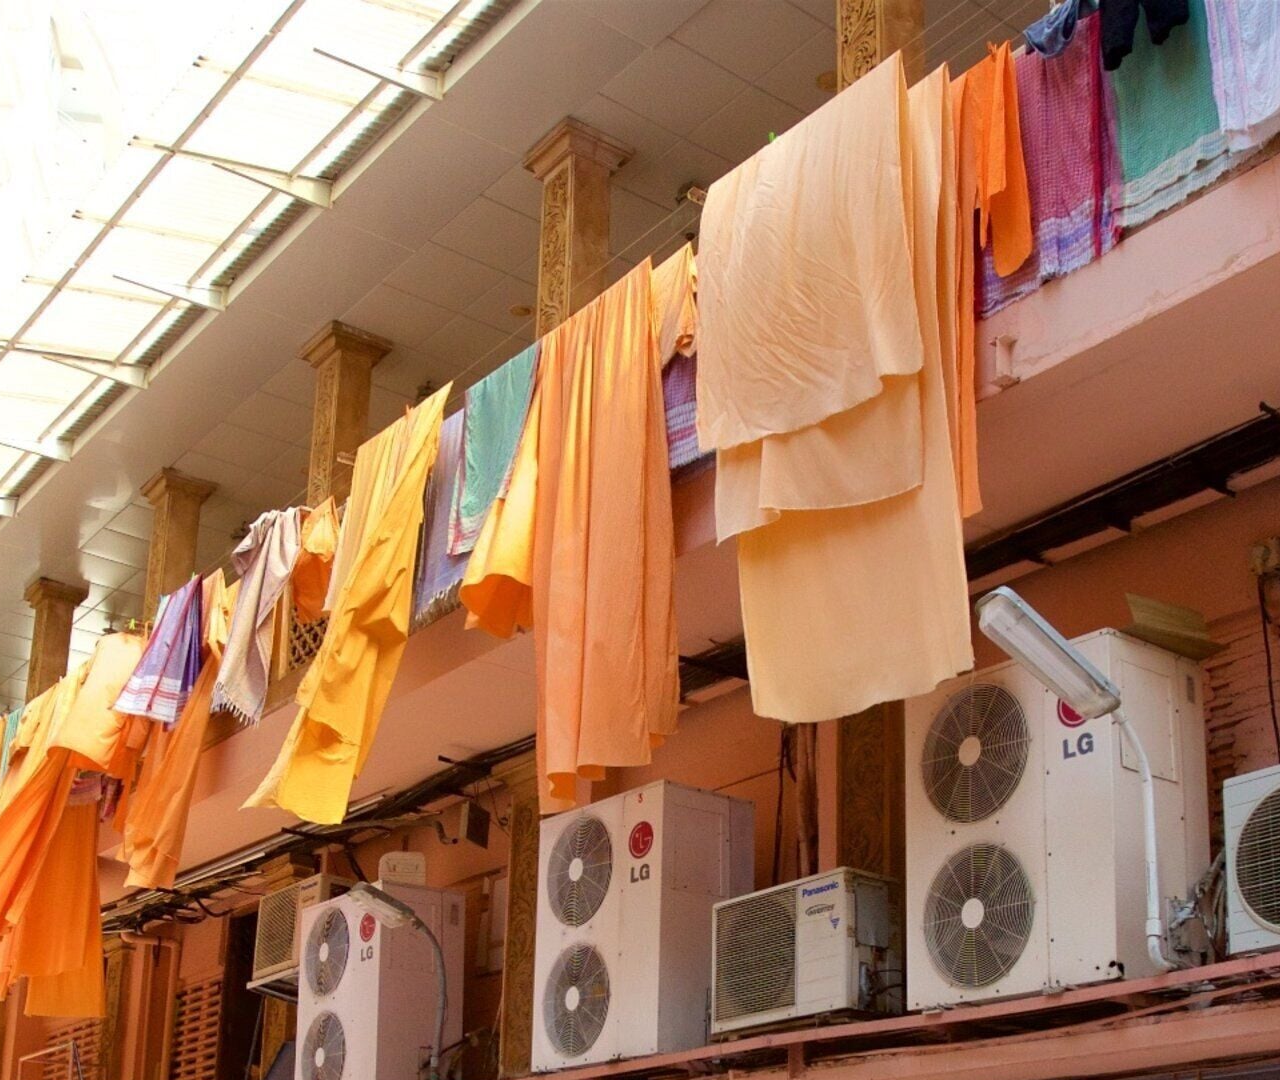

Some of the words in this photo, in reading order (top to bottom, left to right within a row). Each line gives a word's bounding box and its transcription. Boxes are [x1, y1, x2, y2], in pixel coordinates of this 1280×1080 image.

[1062, 732, 1094, 760] LG
[630, 863, 650, 884] LG
[802, 880, 839, 898] Panasonic
[360, 945, 374, 962] LG
